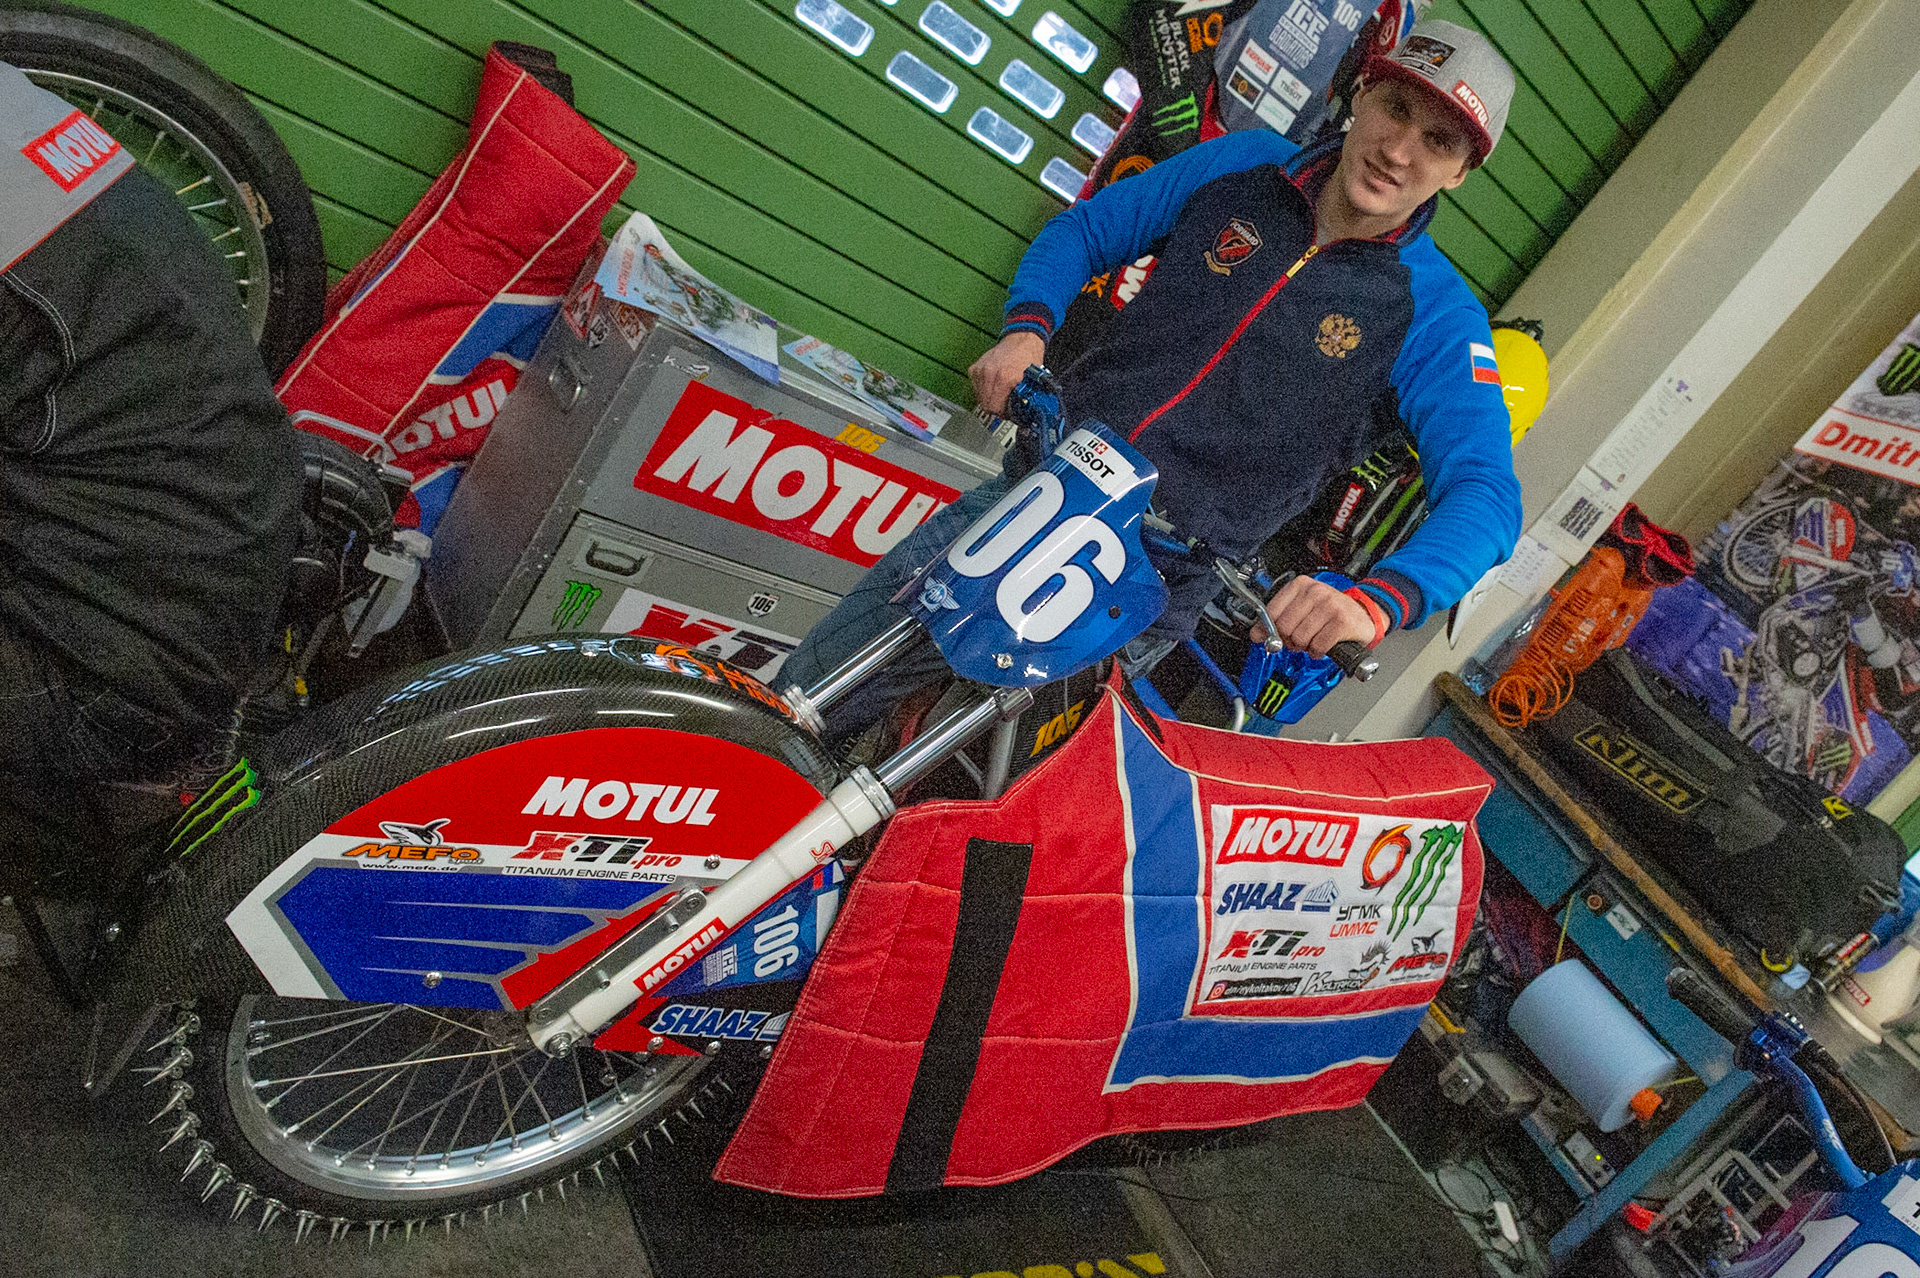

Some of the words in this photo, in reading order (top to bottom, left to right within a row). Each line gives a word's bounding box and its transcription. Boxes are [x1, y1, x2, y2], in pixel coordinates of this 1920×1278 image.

[1169, 21, 1191, 73] BLACK
[1456, 84, 1489, 127] MOTUL
[834, 423, 887, 454] 106
[1812, 420, 1920, 472] Dmitr
[1066, 440, 1115, 480] TISSOT
[653, 408, 953, 556] MOTU
[1333, 487, 1362, 530] MOTUL
[750, 595, 775, 614] 106
[521, 776, 719, 826] MOTUL
[344, 843, 481, 863] MEFO
[1226, 816, 1351, 861] MOTUL
[362, 861, 459, 873] www.mefo.de
[504, 865, 574, 877] TITANIUM
[577, 868, 629, 881] ENGINE
[631, 872, 677, 884] PARTS
[1216, 882, 1307, 917] SHAAZ
[643, 926, 724, 990] MOTUL
[754, 905, 800, 978] 106
[1208, 962, 1250, 976] TITANIUM
[1251, 962, 1288, 971] ENGINE
[1289, 962, 1318, 971] PARTS
[650, 1004, 772, 1040] SHAAZ
